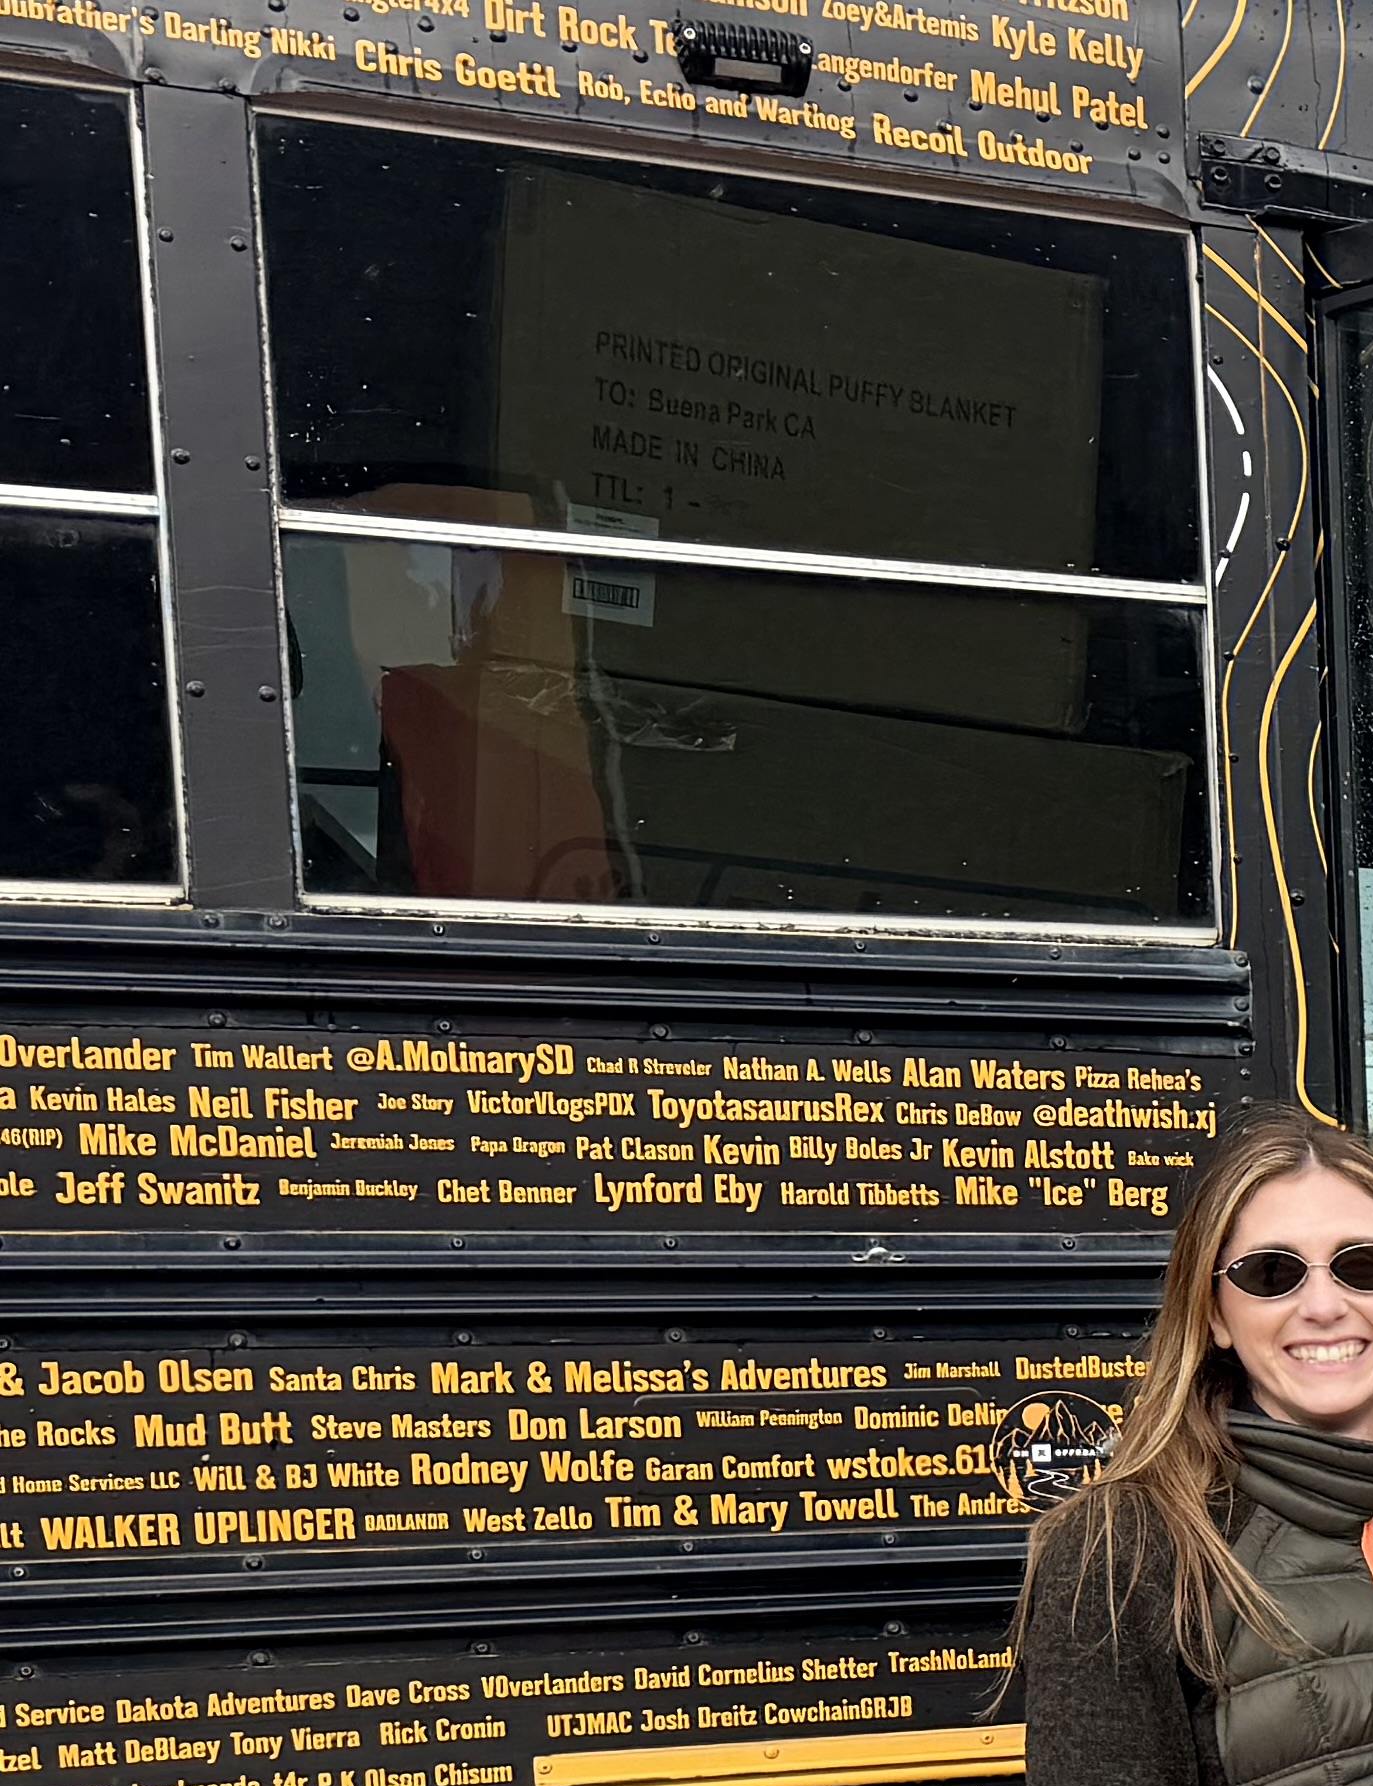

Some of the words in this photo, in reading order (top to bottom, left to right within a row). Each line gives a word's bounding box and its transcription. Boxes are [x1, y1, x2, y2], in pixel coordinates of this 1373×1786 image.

[559, 7, 638, 51] Rock
[992, 16, 1056, 60] Kyle
[164, 12, 263, 59] Darling
[270, 28, 337, 60] Nikki
[356, 40, 442, 81] Chris
[706, 95, 749, 118] and
[755, 96, 856, 139] Warthog
[873, 113, 968, 157] Recoil
[978, 131, 1092, 174] Outdoor
[1072, 86, 1148, 129] Patel
[596, 332, 699, 372] PRINTED
[708, 351, 821, 397] ORIGINAL
[830, 374, 903, 407] PUFFY
[909, 391, 1016, 429] BLANKET
[649, 389, 720, 424] Buena
[728, 405, 777, 433] Park
[785, 412, 816, 439] CA
[592, 426, 662, 461] MADE
[676, 439, 698, 467] IN
[712, 448, 785, 480] CHINA
[191, 1043, 234, 1068] Tim
[723, 1057, 798, 1081] Nathan
[807, 1059, 825, 1081] A.
[833, 1060, 891, 1083] Wells
[903, 1058, 961, 1087] Alan
[971, 1060, 1065, 1090] Waters
[1076, 1066, 1120, 1088] Pizza
[30, 1086, 97, 1111] Kevin
[107, 1088, 175, 1112] Hales
[189, 1087, 253, 1118] Neil
[265, 1088, 358, 1120] Fisher
[896, 1102, 947, 1125] Chris
[956, 1104, 1021, 1126] DeBow
[1033, 1098, 1216, 1138] @deathwish.xj
[80, 1123, 156, 1156] Mike
[170, 1125, 317, 1158] McDaniel
[576, 1137, 613, 1159] Pat
[622, 1137, 694, 1160] Clason
[910, 1138, 932, 1160] Jr
[943, 1139, 1014, 1168] Kevin
[56, 1172, 125, 1204] Jeff
[438, 1179, 491, 1202] Chet
[499, 1180, 576, 1203] Benner
[595, 1173, 702, 1211] Lynford
[781, 1183, 849, 1205] Harold
[857, 1183, 939, 1205] Tibbetts
[955, 1176, 1018, 1205] Mike
[39, 1361, 144, 1395] Jacob
[159, 1360, 253, 1392] Olsen
[270, 1367, 342, 1391] Santa
[352, 1366, 415, 1390] Chris
[905, 1363, 931, 1379] Jim
[937, 1363, 1001, 1378] Marshall
[37, 1420, 115, 1446] Rocks
[134, 1414, 206, 1447] Mud
[311, 1415, 381, 1439] Steve
[392, 1414, 491, 1438] Masters
[509, 1409, 566, 1440] Don
[855, 1406, 939, 1429] Dominic
[151, 1472, 180, 1489] LLC
[256, 1465, 276, 1489] &
[286, 1464, 317, 1488] BJ
[327, 1463, 399, 1487] White
[646, 1458, 713, 1481] Garan
[722, 1455, 815, 1479] Comfort
[41, 1514, 180, 1550] WALKER
[463, 1508, 526, 1532] West
[534, 1506, 592, 1530] Zello
[605, 1497, 661, 1527] Tim
[911, 1495, 949, 1517] The
[208, 1689, 335, 1716] Adventures
[346, 1685, 400, 1707] Dave
[409, 1681, 470, 1703] Cross
[635, 1666, 690, 1689] David
[699, 1661, 794, 1685] Cornelius
[802, 1658, 877, 1681] Shetter
[59, 1742, 117, 1768] Matt
[230, 1732, 282, 1759] Tony
[291, 1728, 360, 1750] Vierra
[380, 1721, 428, 1745] Rick
[641, 1709, 690, 1731] Josh
[435, 1763, 512, 1786] Chisum
